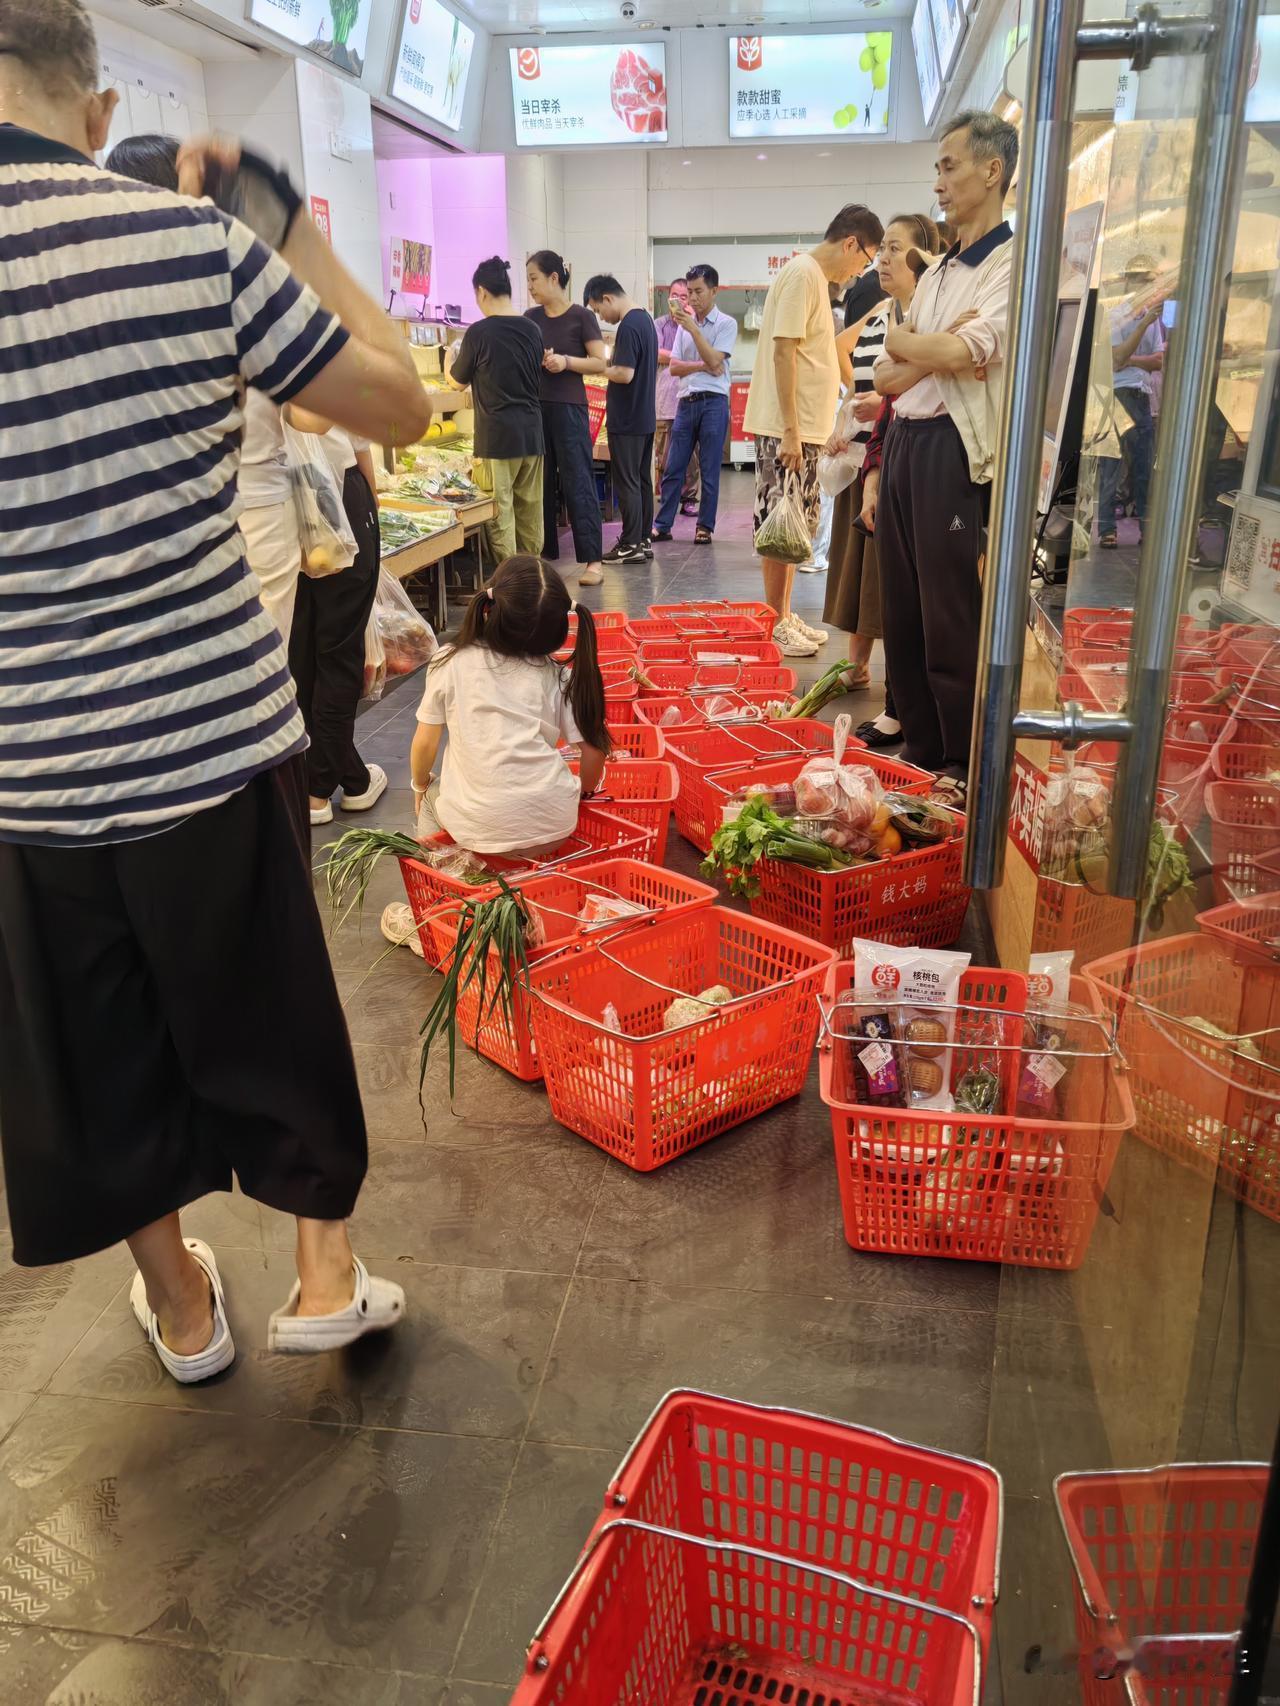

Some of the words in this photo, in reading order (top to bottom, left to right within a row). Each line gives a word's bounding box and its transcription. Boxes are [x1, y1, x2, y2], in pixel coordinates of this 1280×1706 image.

[737, 90, 781, 106] 款款甜蜜
[521, 99, 560, 114] 当日宰杀
[881, 875, 927, 904] 钱大妈
[913, 971, 940, 983] 核桃包
